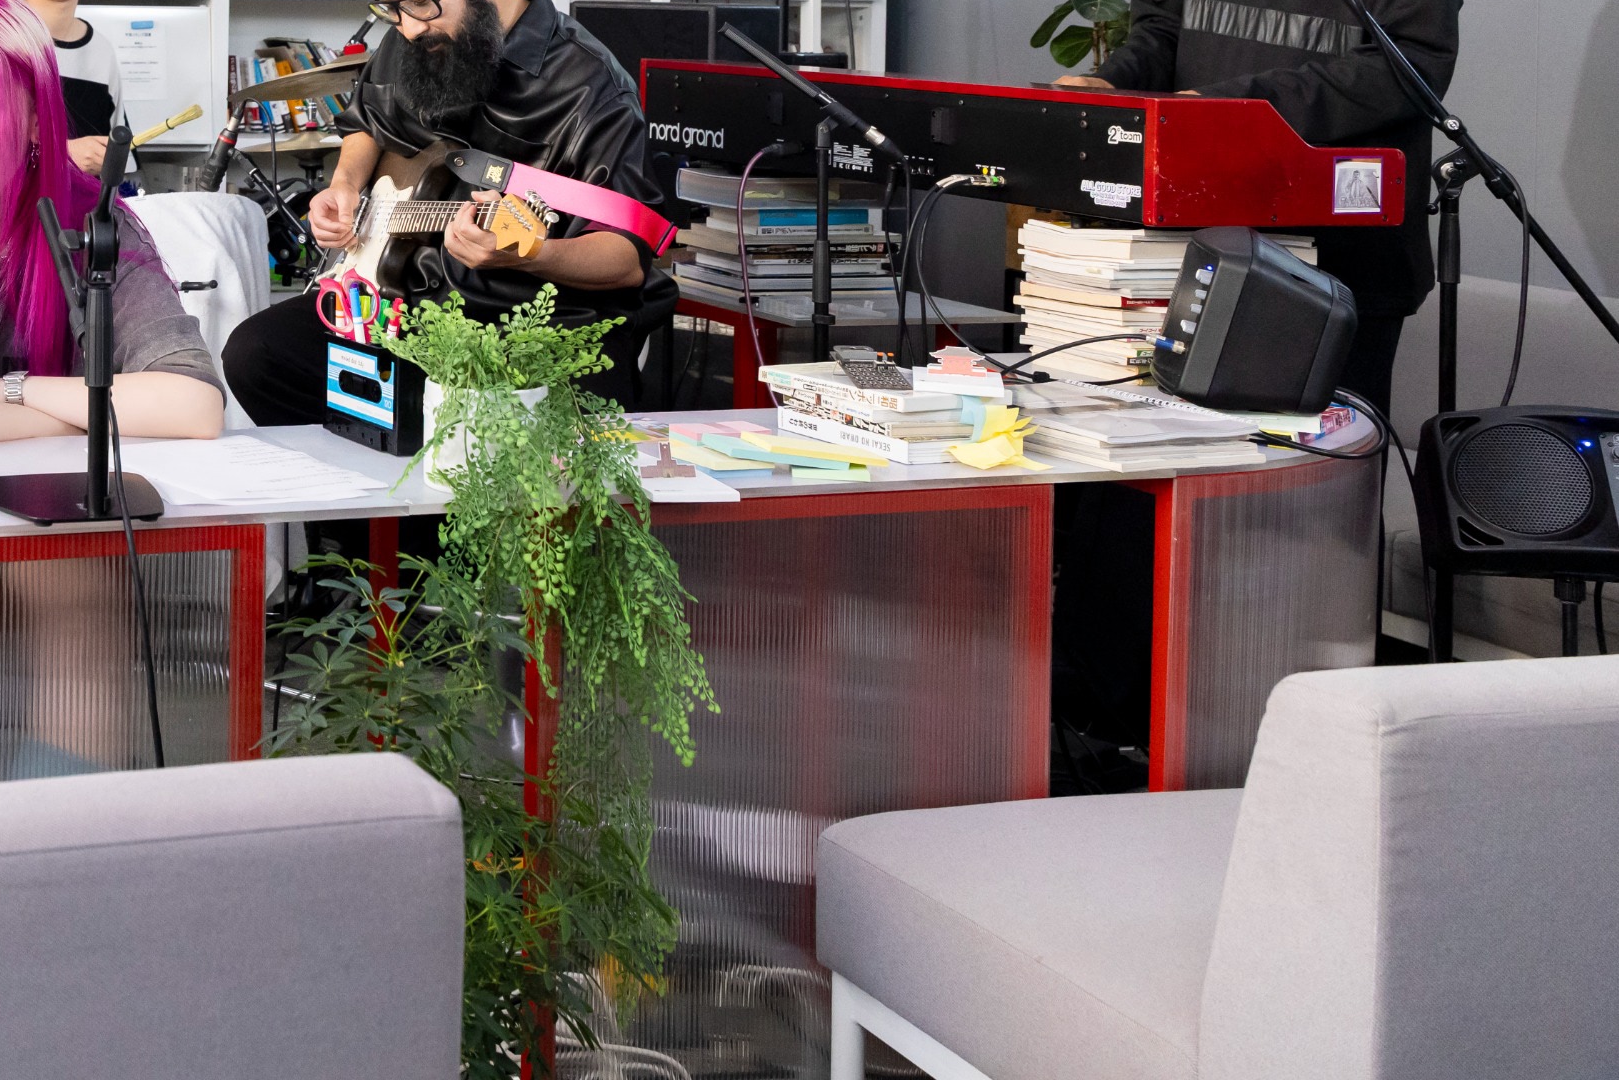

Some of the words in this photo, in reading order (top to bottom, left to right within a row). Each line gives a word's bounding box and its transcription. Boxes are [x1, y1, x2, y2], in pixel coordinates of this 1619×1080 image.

[649, 121, 680, 143] nord
[682, 126, 724, 150] grand
[839, 430, 859, 445] OWARI
[860, 435, 870, 446] NO
[870, 438, 891, 452] SEKAI
